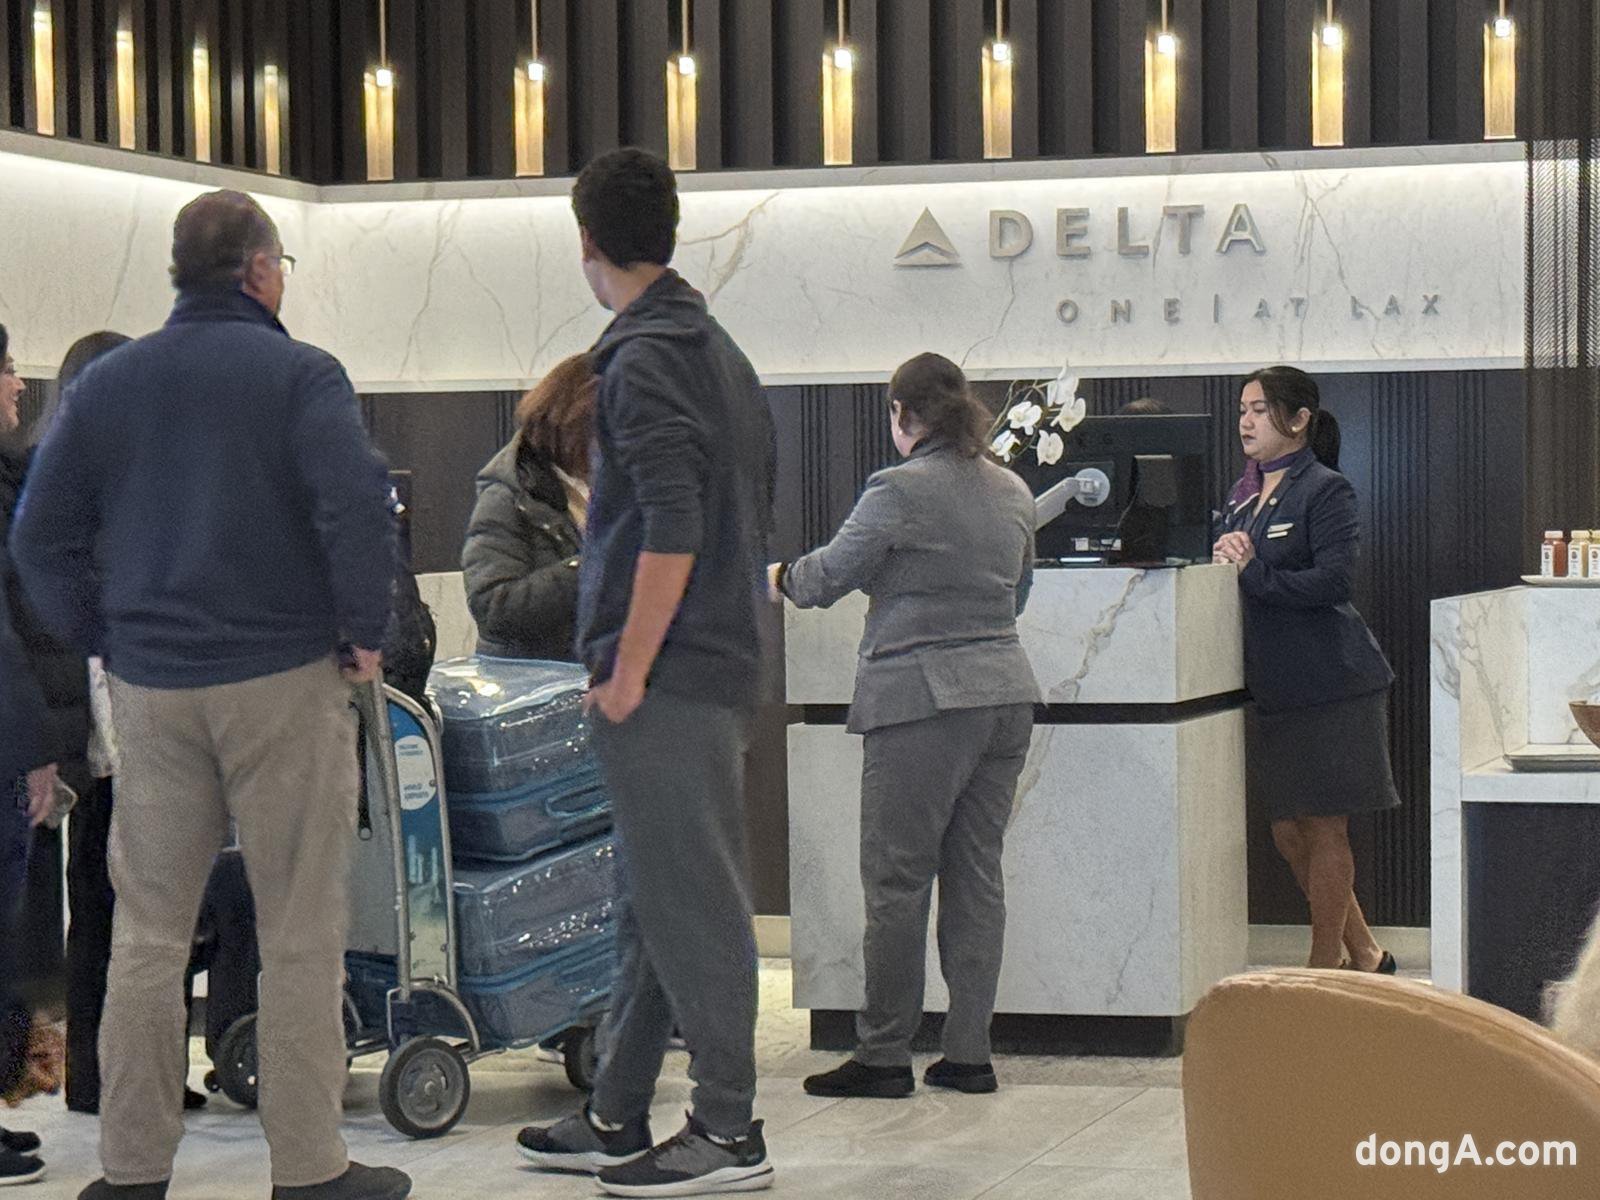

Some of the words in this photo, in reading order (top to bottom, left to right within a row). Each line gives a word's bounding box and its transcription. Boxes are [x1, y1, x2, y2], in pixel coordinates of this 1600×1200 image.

[989, 203, 1266, 258] DELTA
[1056, 298, 1180, 325] ONE
[1254, 298, 1305, 319] AT
[1350, 294, 1440, 320] LAX
